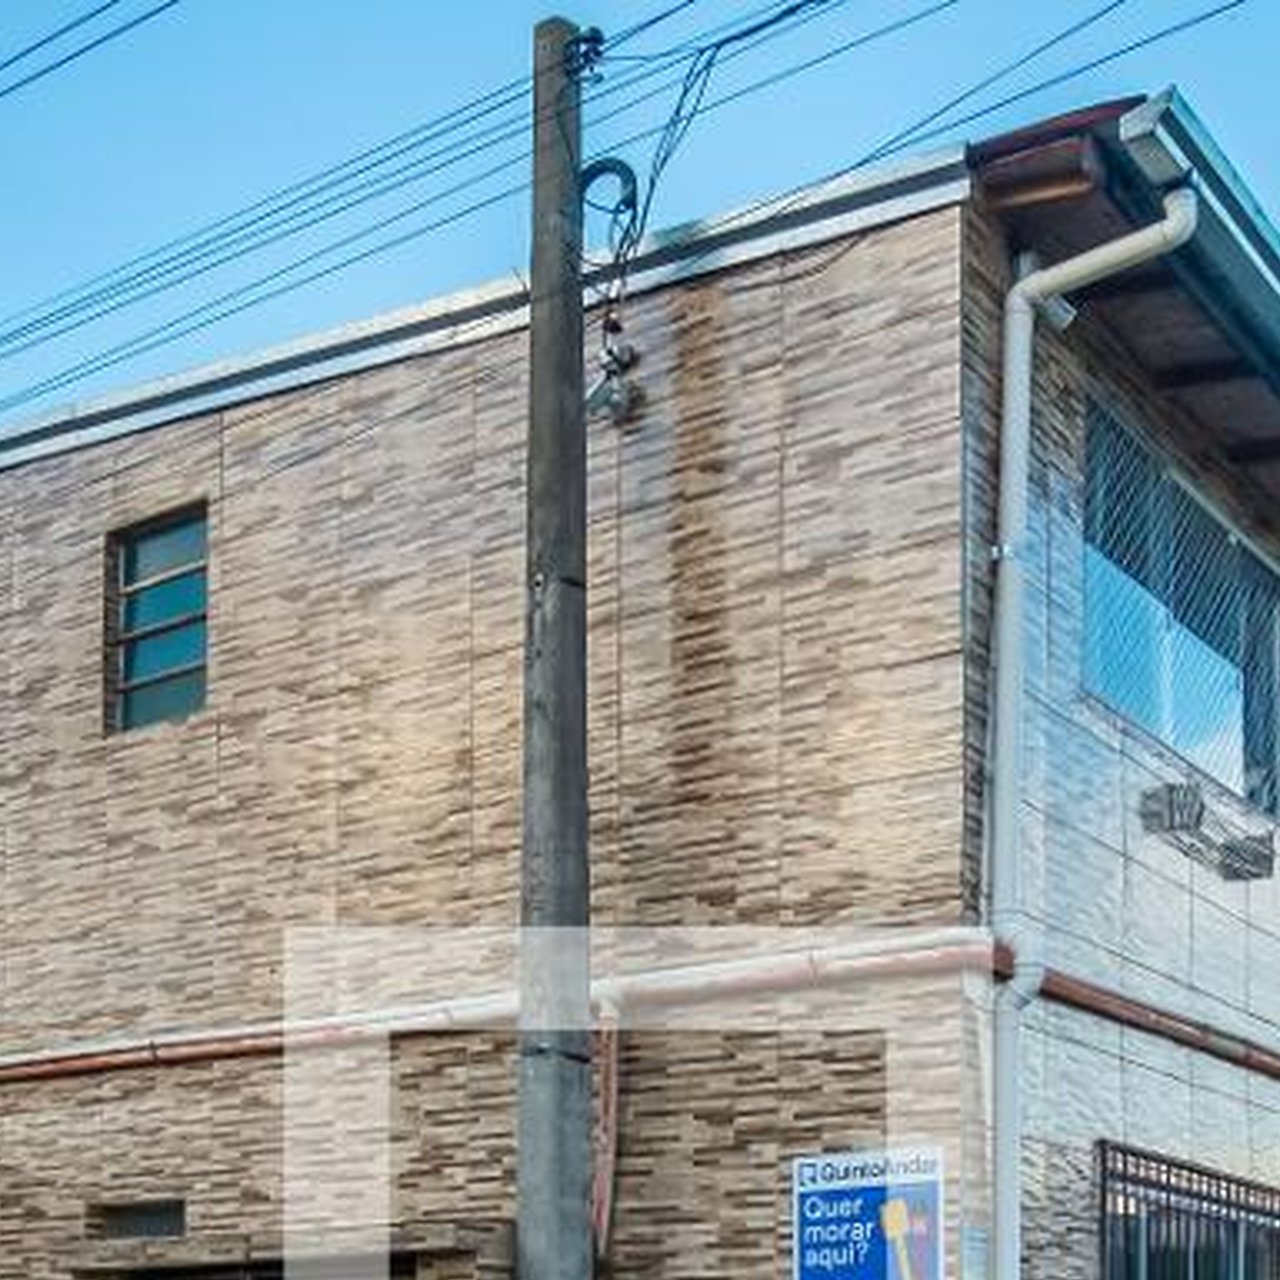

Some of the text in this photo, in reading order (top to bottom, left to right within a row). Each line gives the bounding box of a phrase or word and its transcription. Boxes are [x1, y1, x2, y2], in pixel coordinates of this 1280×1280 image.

[803, 1196, 863, 1219] Quer
[804, 1222, 875, 1243] morar
[803, 1244, 869, 1271] aqui?
